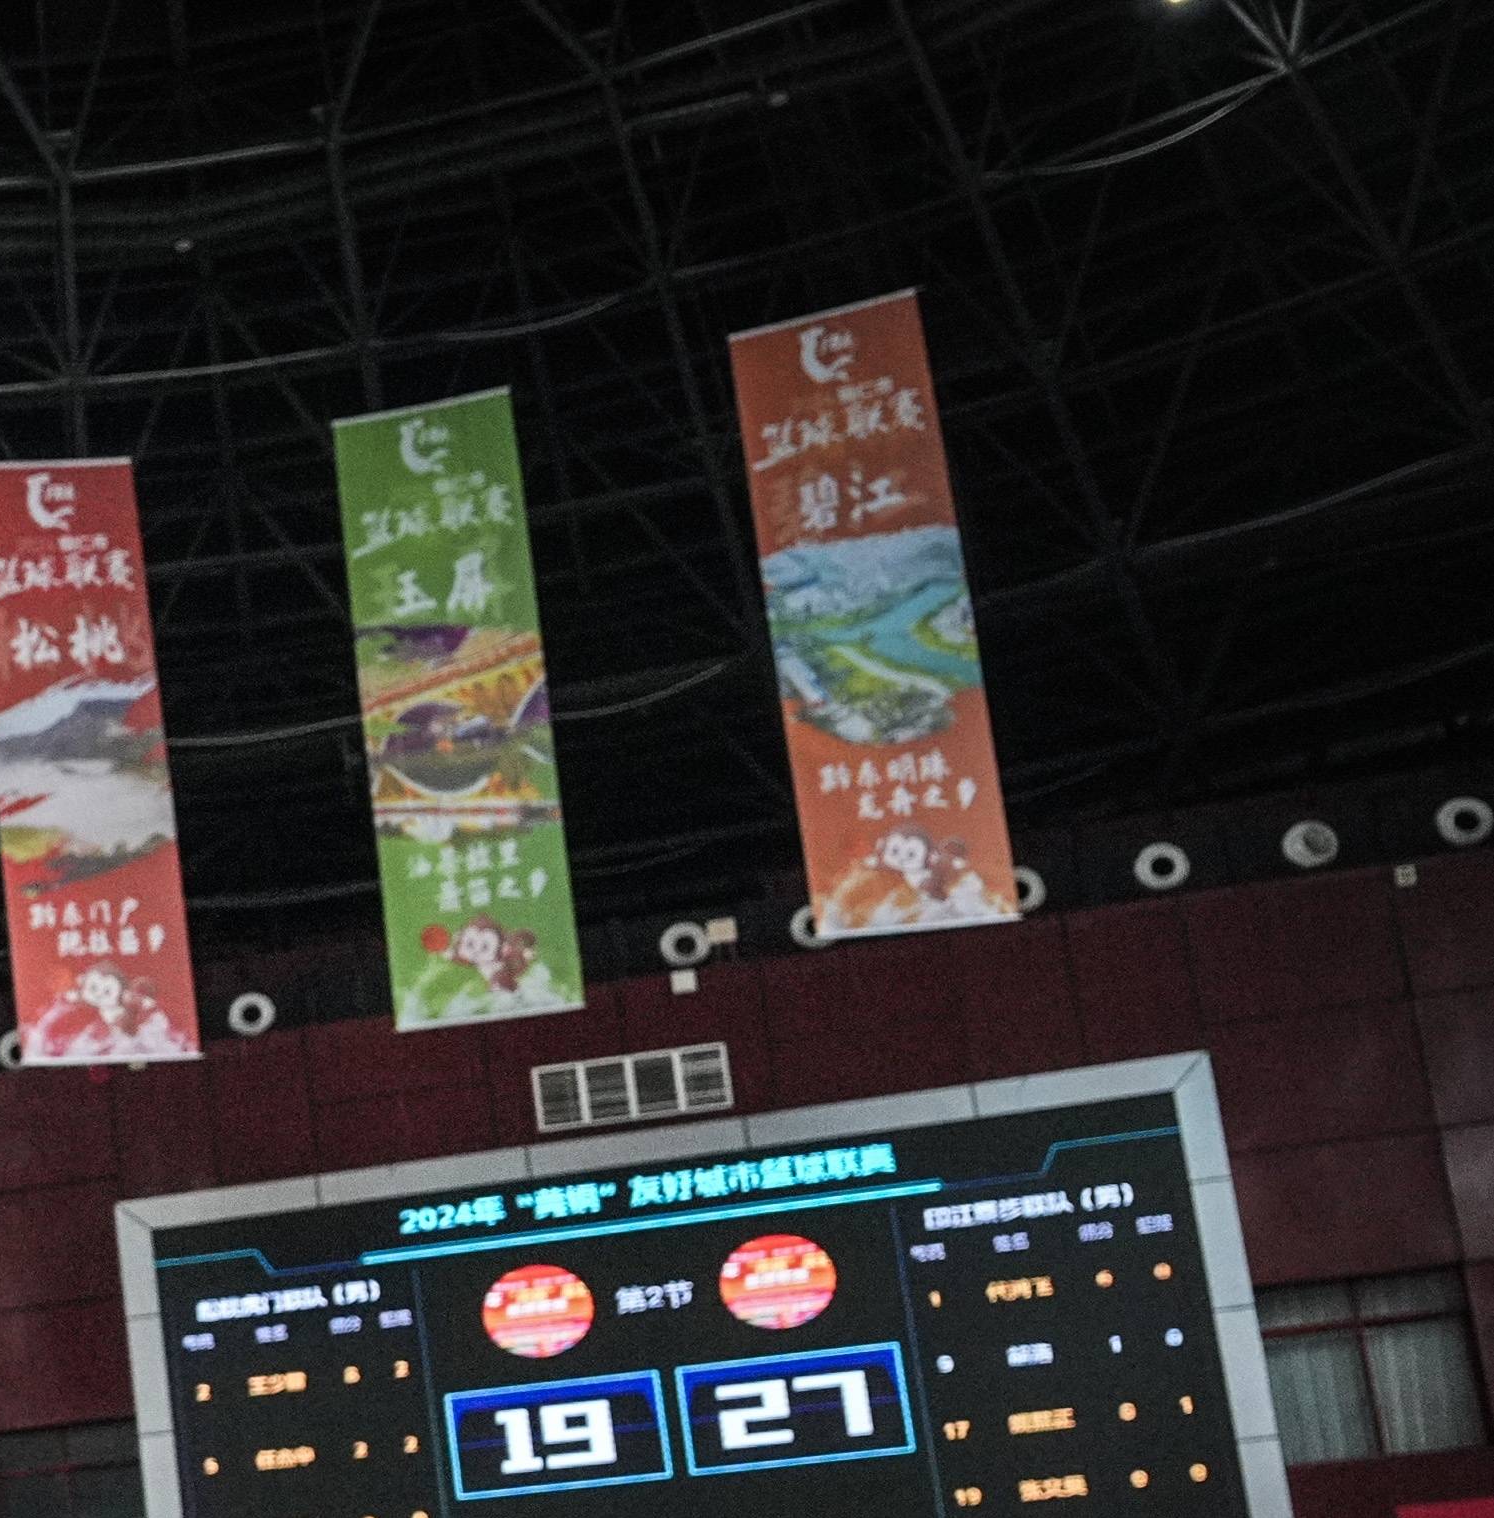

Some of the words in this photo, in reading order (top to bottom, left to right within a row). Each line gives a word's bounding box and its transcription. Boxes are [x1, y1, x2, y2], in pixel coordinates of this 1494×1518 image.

[798, 471, 907, 532] 碧江
[10, 615, 126, 670] 松桃
[617, 1280, 694, 1315] 第2节
[494, 1398, 619, 1475] 19
[715, 1369, 874, 1449] 27
